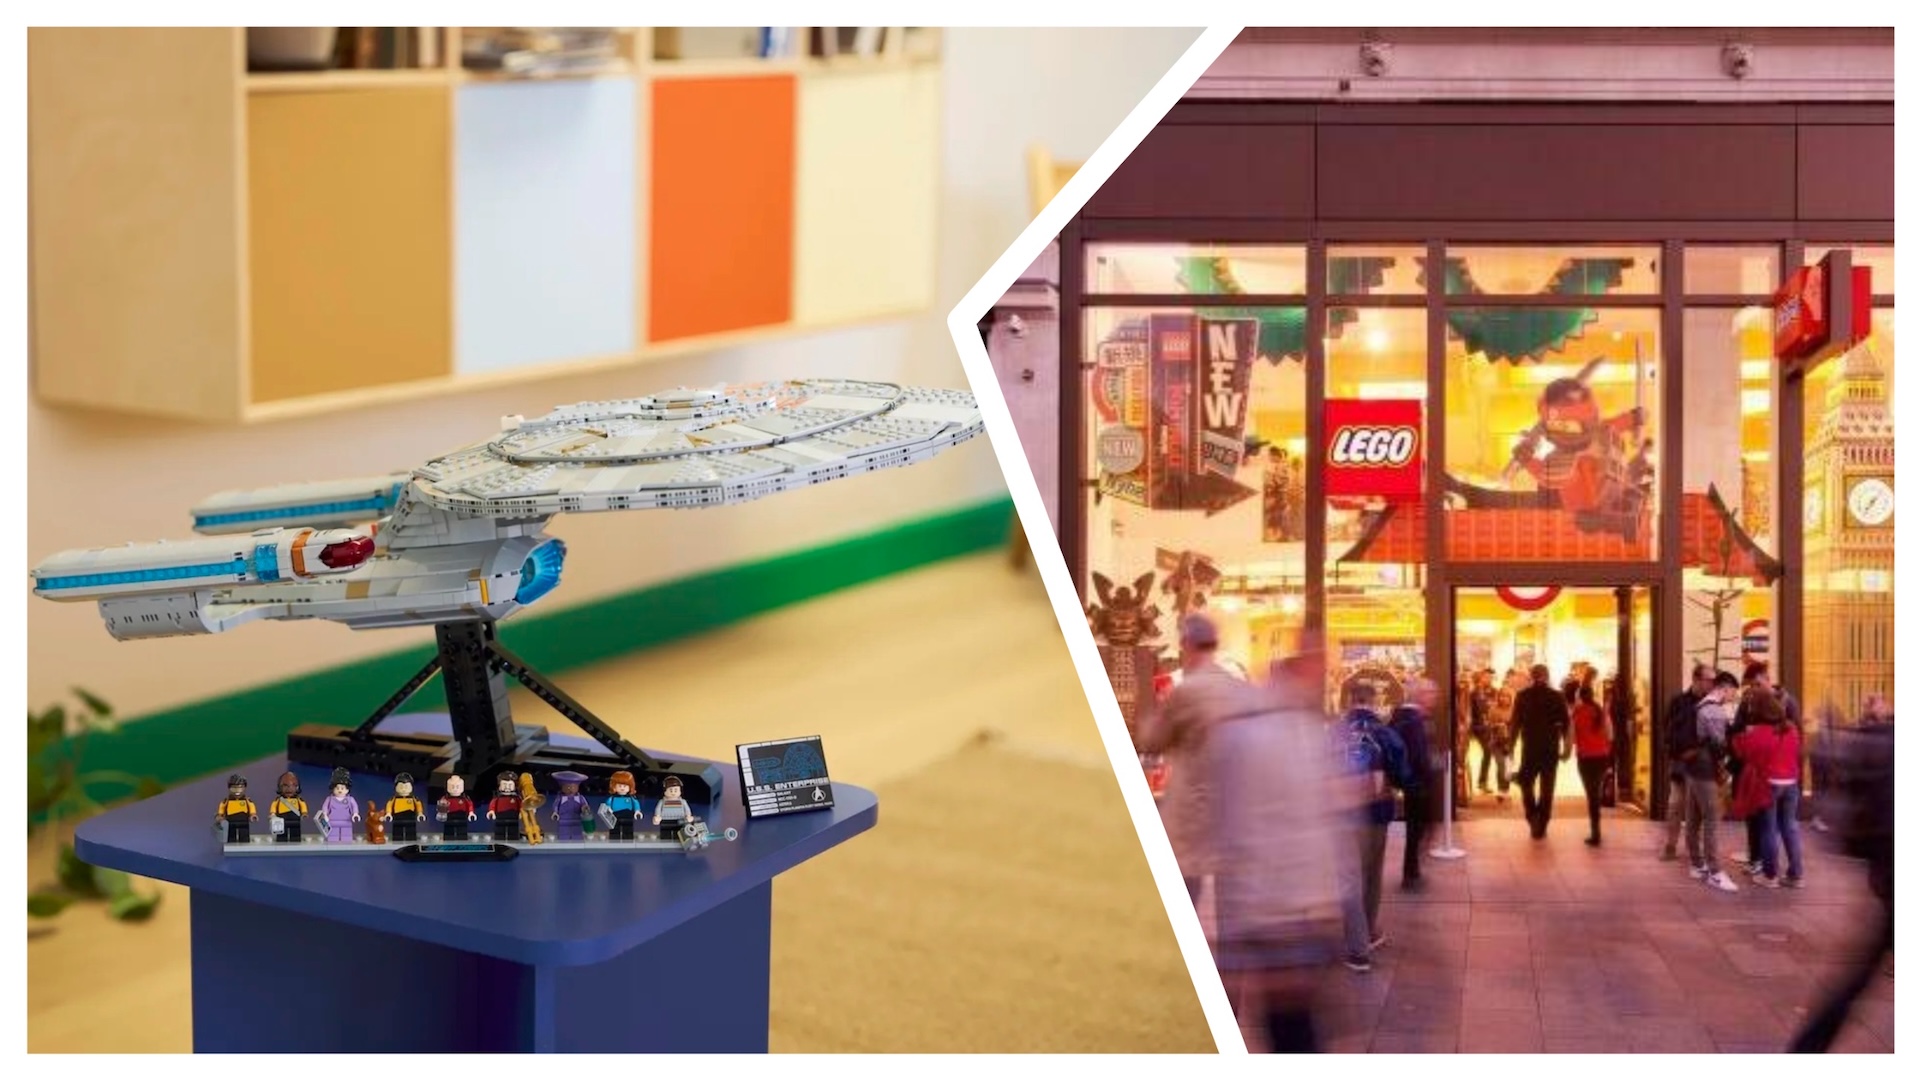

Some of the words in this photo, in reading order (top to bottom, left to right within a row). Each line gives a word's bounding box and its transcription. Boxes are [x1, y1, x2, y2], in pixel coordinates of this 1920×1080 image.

[1204, 323, 1243, 428] NEW
[1102, 438, 1137, 457] NEW
[1330, 427, 1416, 466] LEGO
[747, 784, 774, 793] U.S.S.
[775, 777, 829, 790] ENTERPRISE
